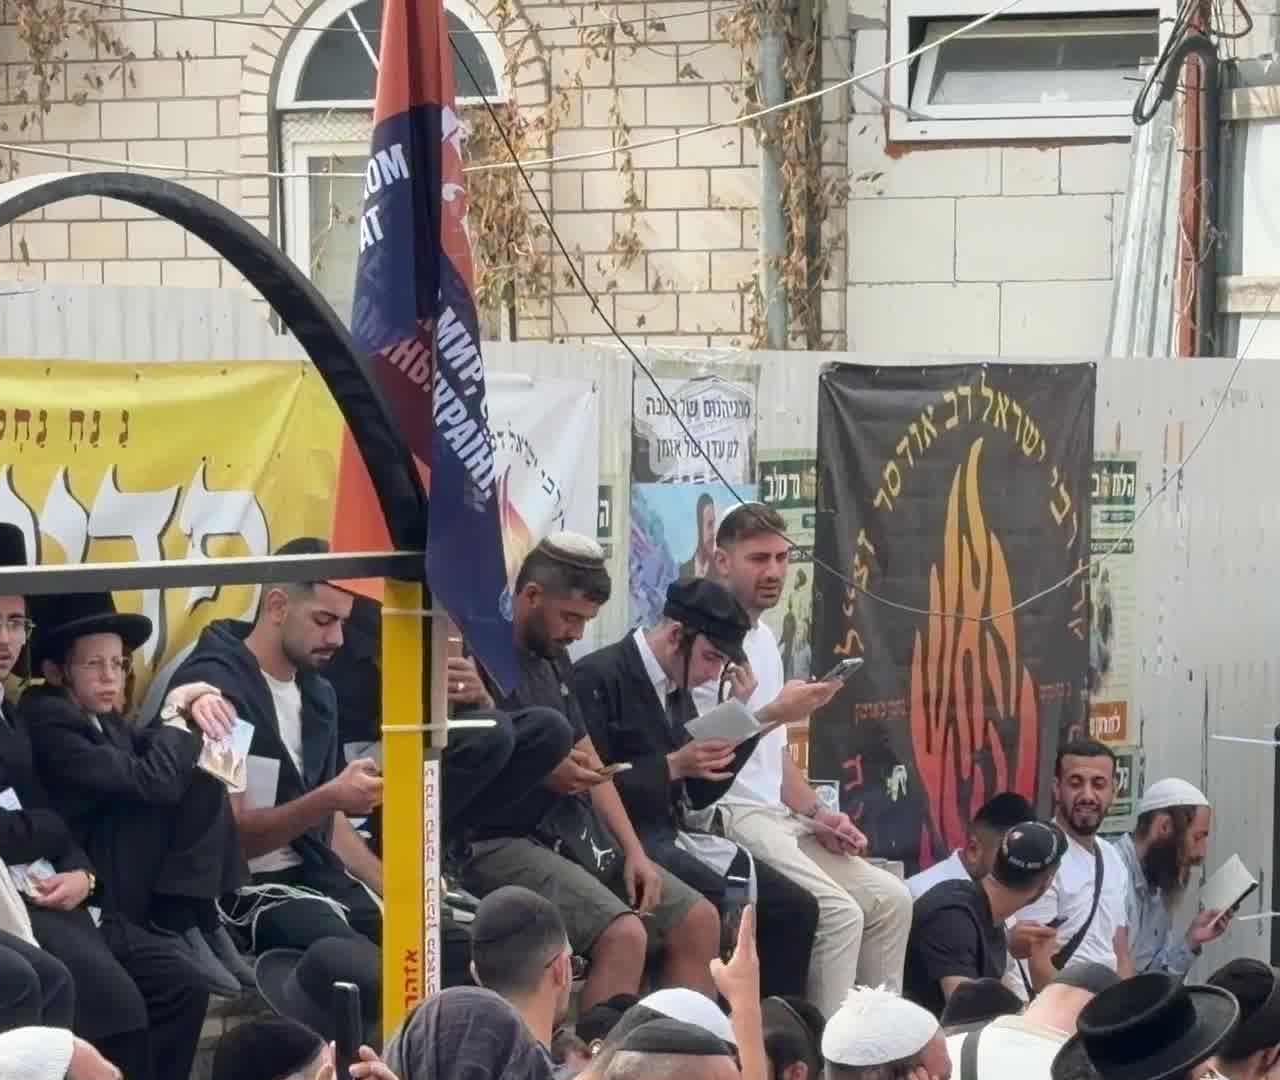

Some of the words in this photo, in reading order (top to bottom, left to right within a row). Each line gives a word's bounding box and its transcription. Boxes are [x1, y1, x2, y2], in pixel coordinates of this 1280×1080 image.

[437, 305, 485, 397] МИР,
[942, 385, 971, 430] דב
[981, 370, 1046, 461] ישראל
[872, 403, 939, 512] אודסר
